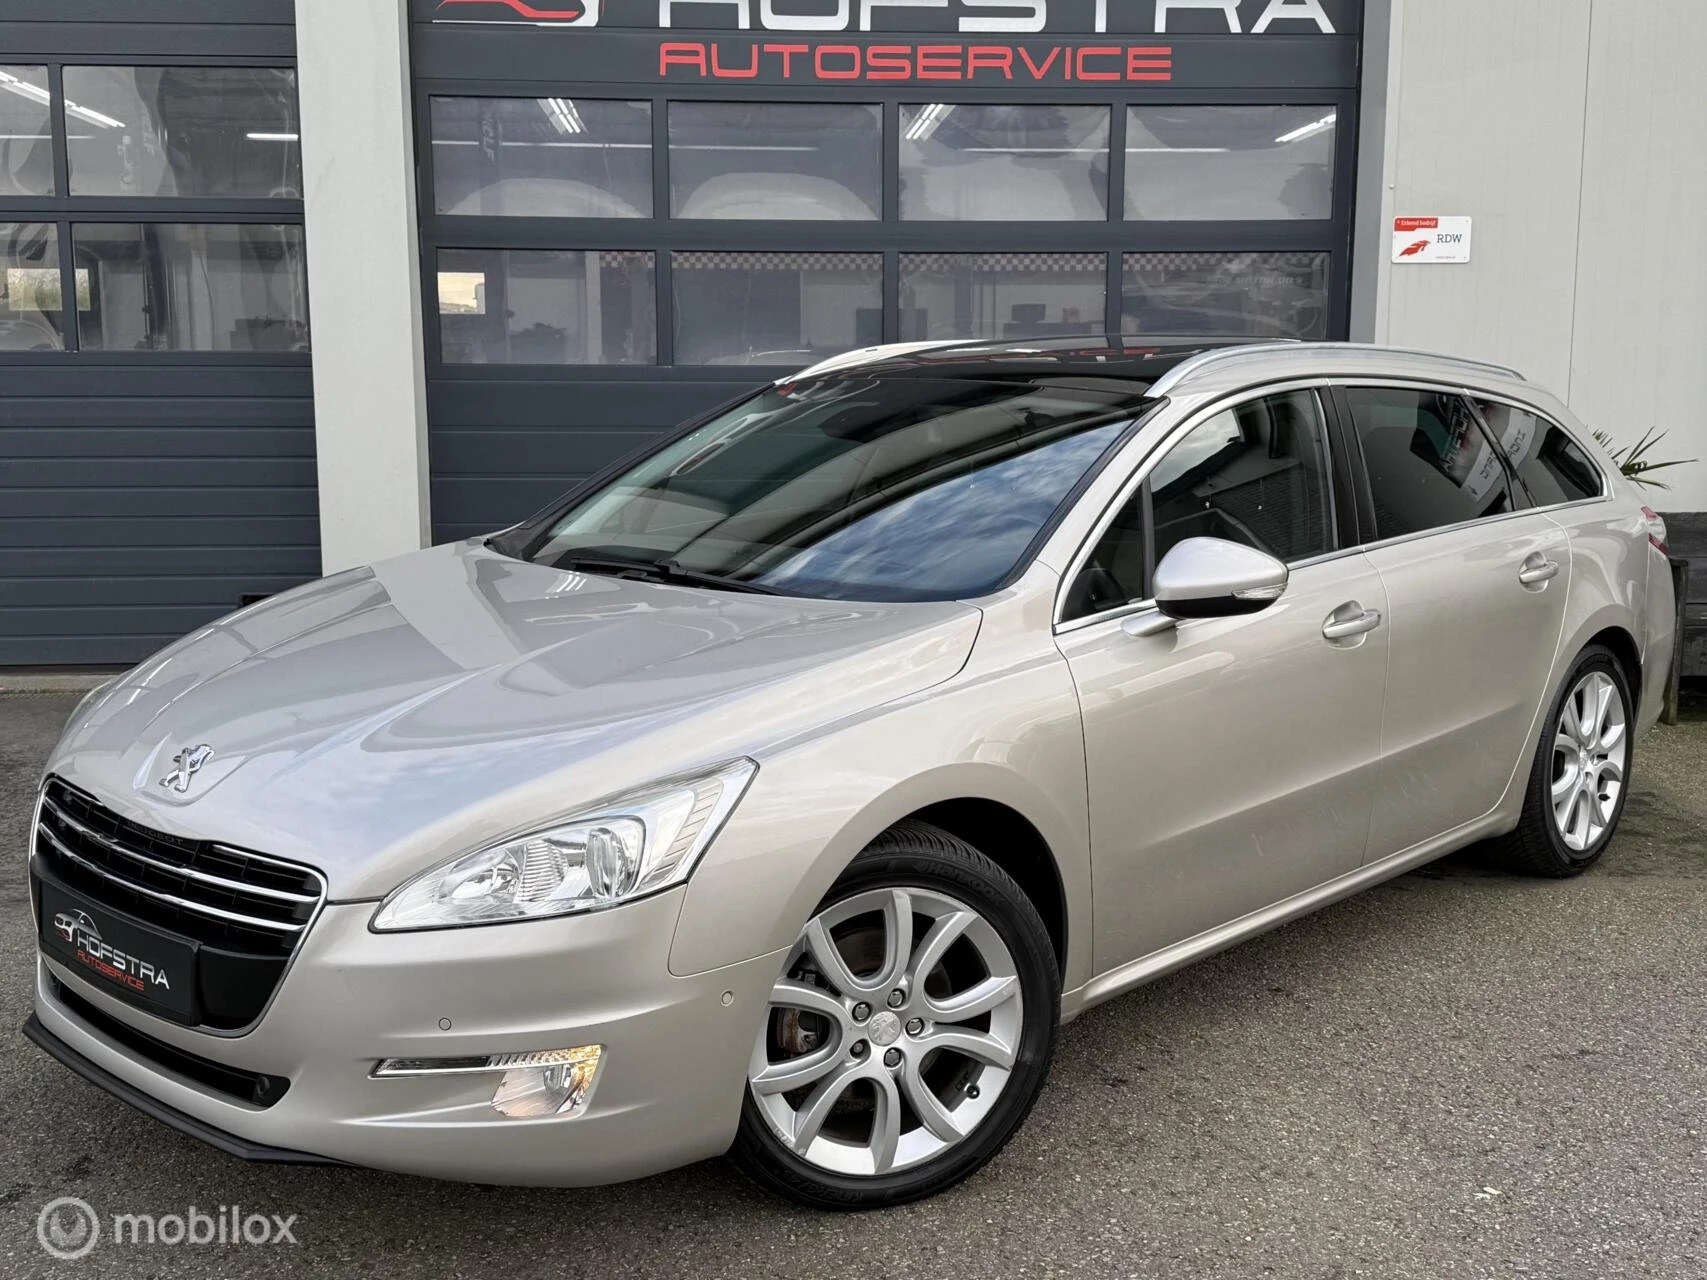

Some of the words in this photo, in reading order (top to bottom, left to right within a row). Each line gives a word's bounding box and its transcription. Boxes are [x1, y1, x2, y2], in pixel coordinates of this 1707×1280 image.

[659, 41, 1172, 81] AUTOSERVICE
[1436, 233, 1463, 244] RDW
[77, 930, 170, 990] HOFSTRA
[77, 949, 145, 992] AUTOSERVICE
